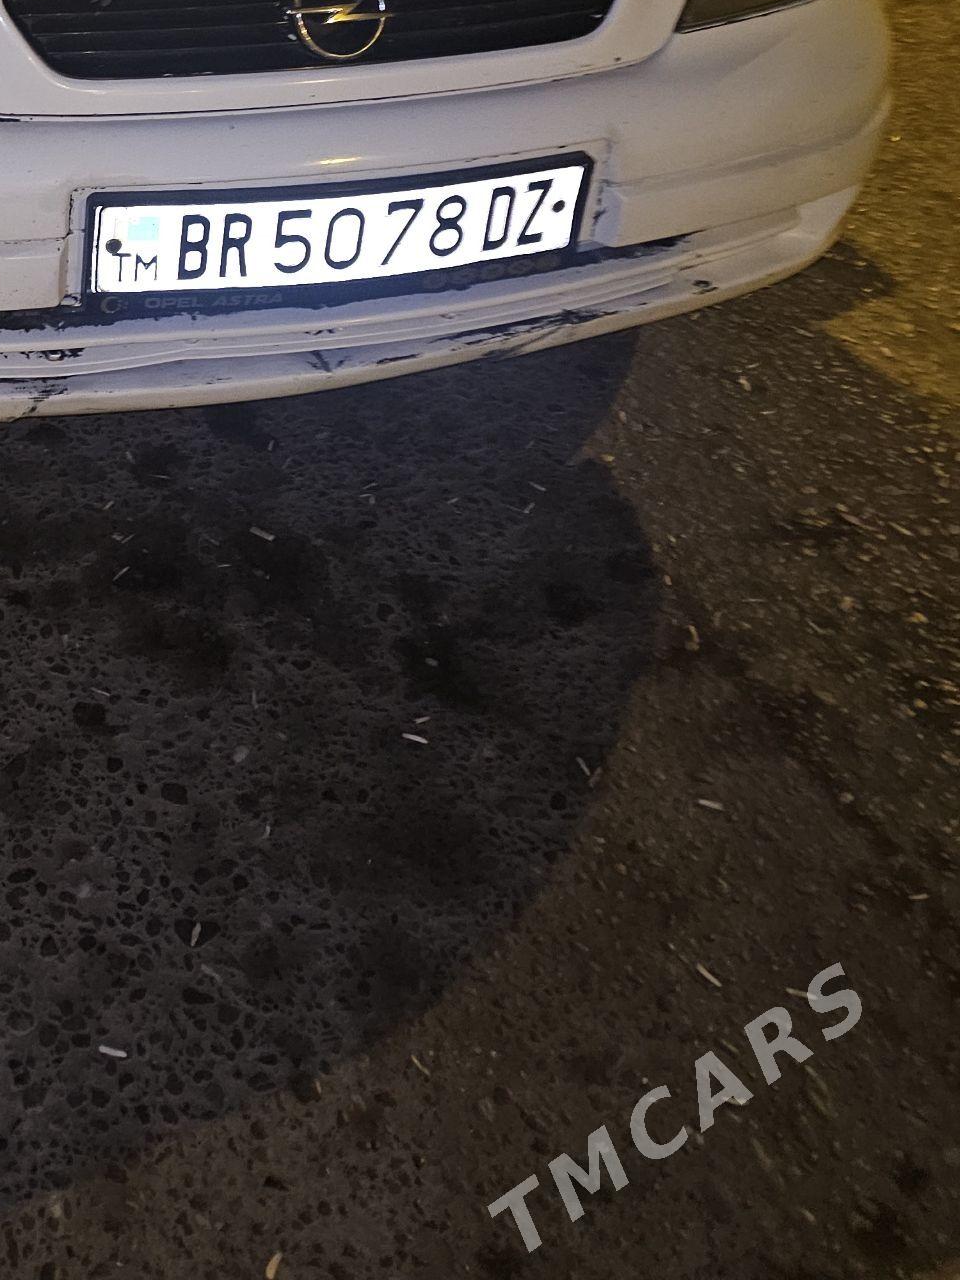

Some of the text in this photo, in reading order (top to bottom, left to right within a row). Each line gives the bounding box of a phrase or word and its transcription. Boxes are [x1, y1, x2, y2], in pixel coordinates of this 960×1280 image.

[112, 252, 159, 282] TM
[144, 292, 283, 309] OPEL ASTRA
